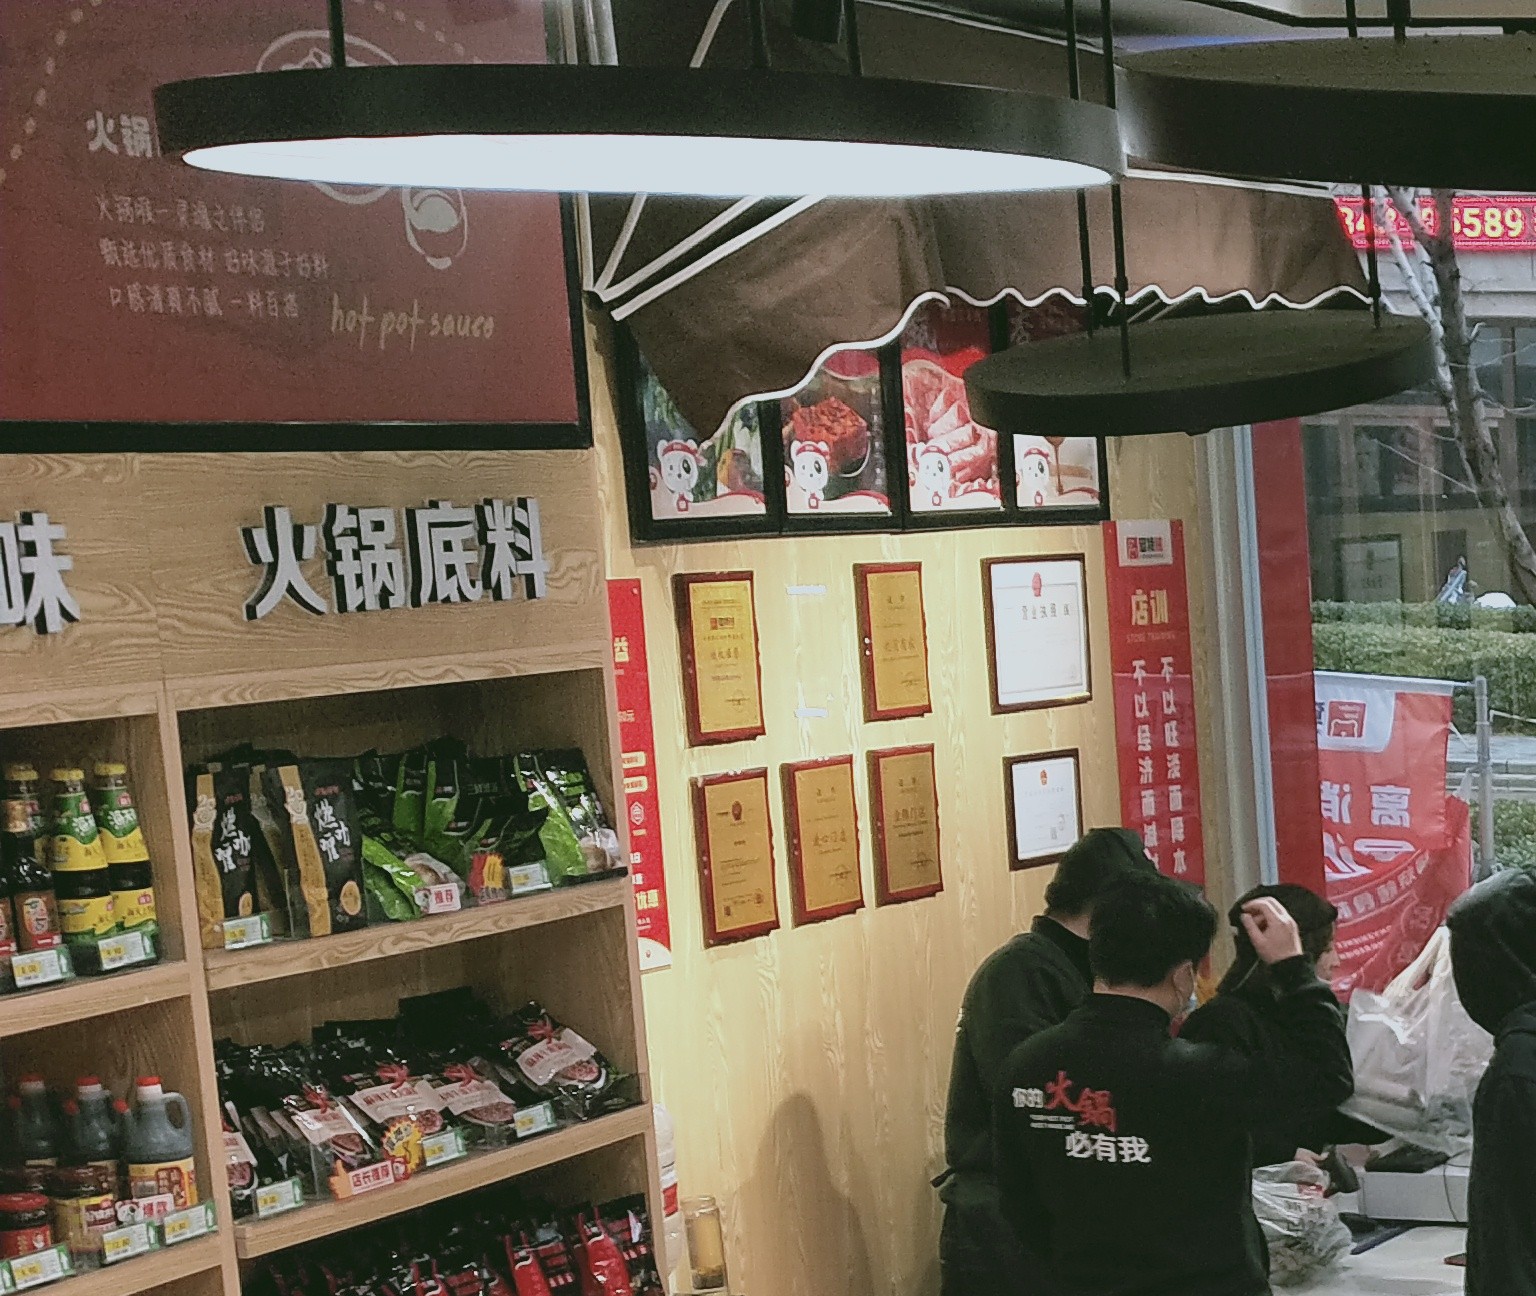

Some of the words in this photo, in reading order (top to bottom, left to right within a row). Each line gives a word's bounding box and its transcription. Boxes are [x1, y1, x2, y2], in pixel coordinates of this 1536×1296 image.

[331, 292, 375, 351] hot
[380, 296, 424, 353] pot
[428, 310, 497, 339] sauce
[240, 497, 551, 622] 火锅底料
[1131, 589, 1169, 626] 店训
[1065, 1130, 1152, 1164] 必有我
